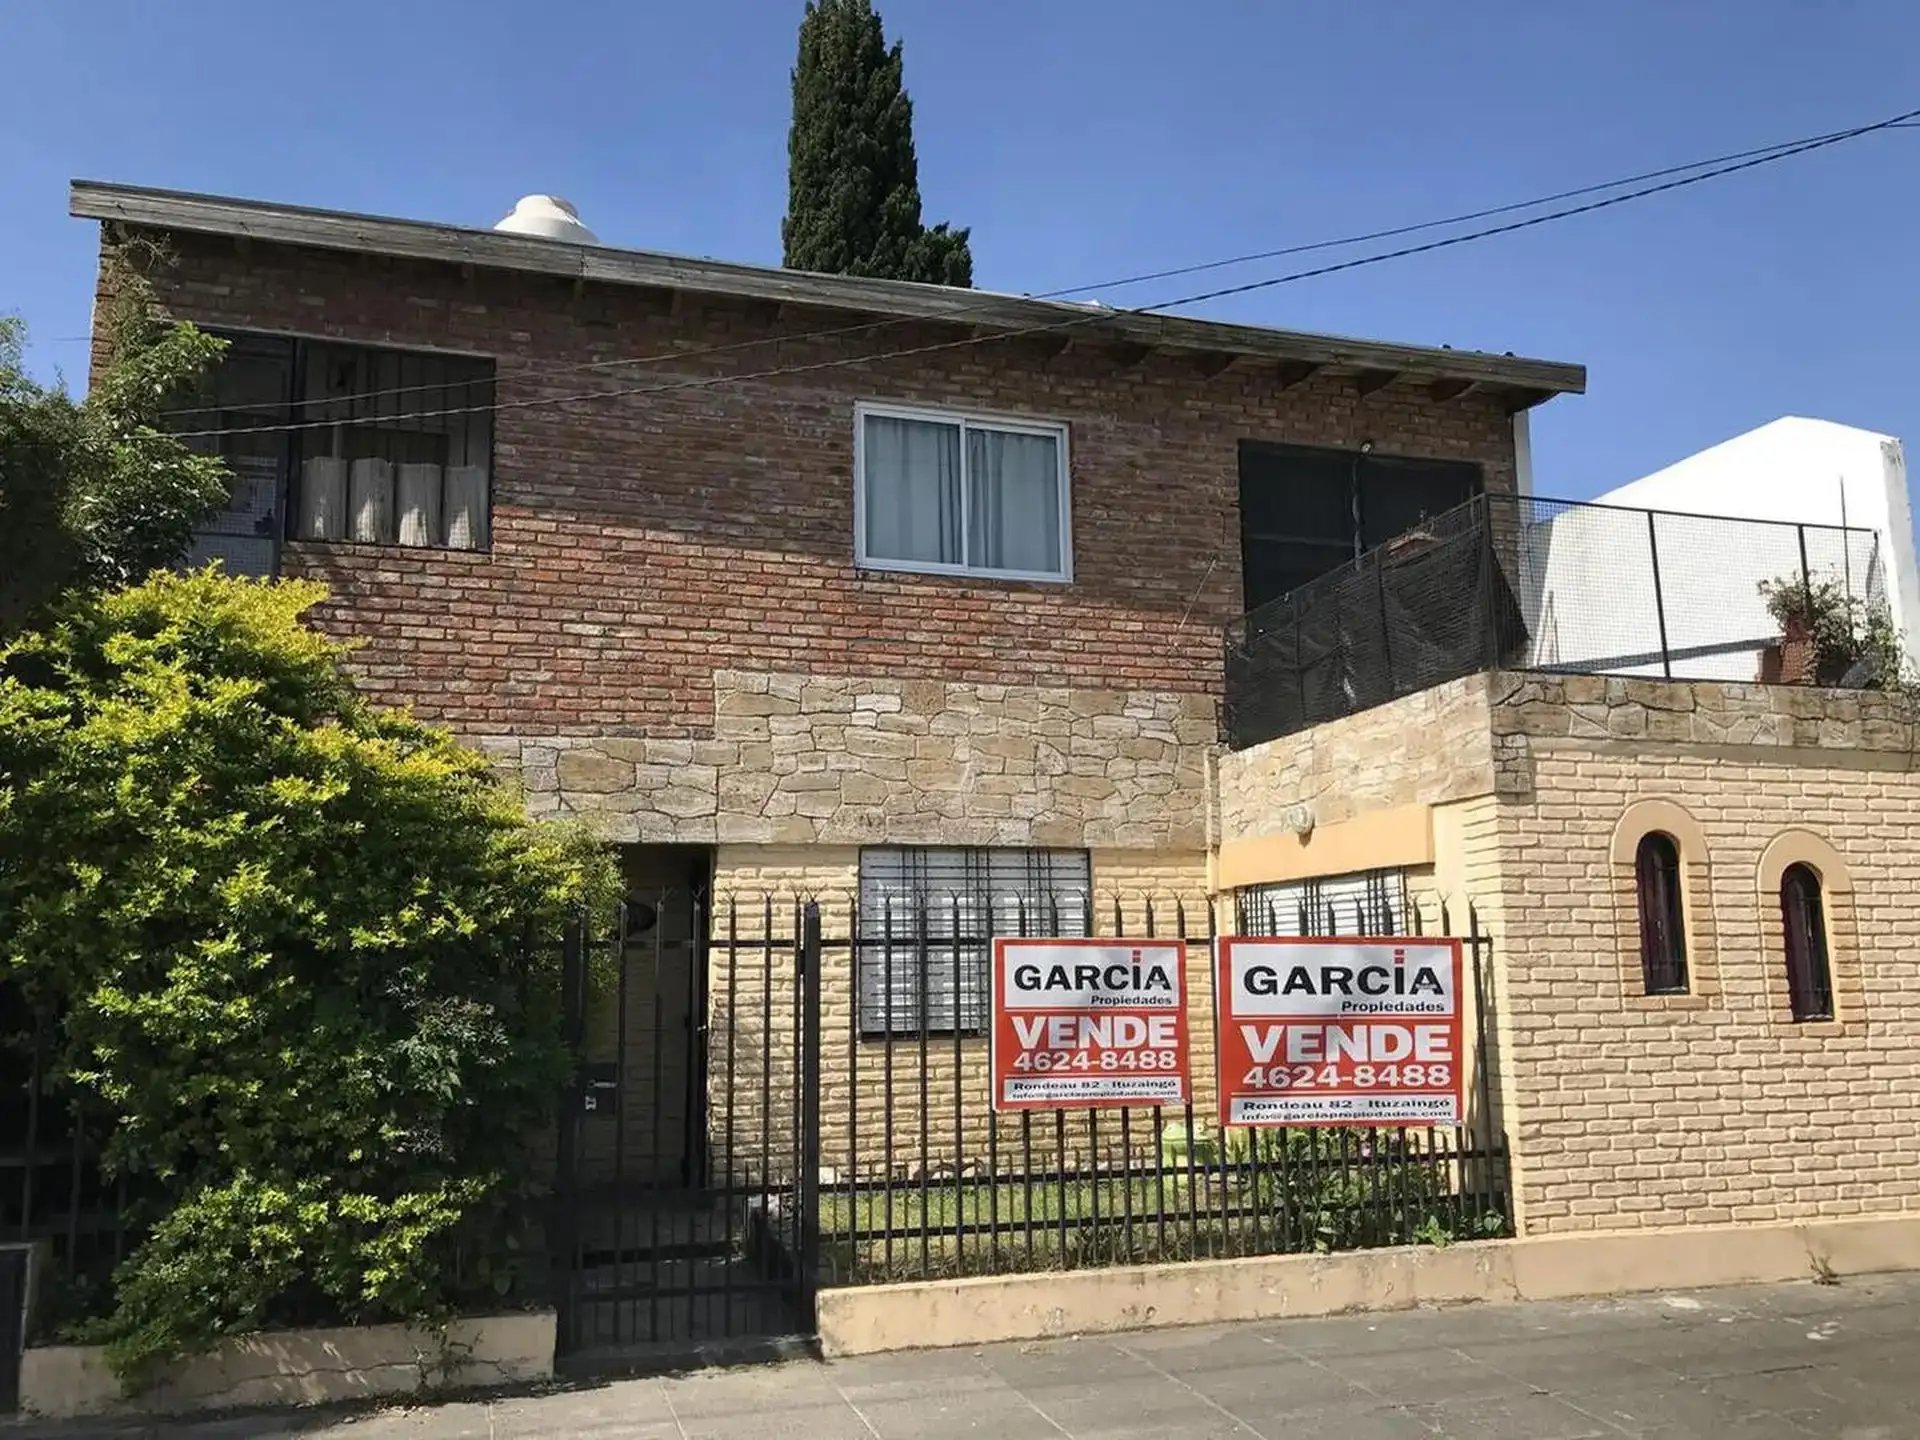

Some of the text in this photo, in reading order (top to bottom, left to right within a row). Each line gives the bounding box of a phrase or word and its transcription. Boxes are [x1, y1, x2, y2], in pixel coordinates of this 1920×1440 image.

[1090, 995, 1172, 1007] Propiedades
[1341, 1001, 1445, 1014] Propiedades
[1011, 1015, 1179, 1050] VENDE
[1239, 1024, 1453, 1064] VENDE
[1013, 1050, 1177, 1072] 4624-8488
[1242, 1064, 1451, 1089] 4624-8488
[1013, 1081, 1077, 1091] Rondeau
[1243, 1101, 1323, 1111] Rondeau
[1328, 1099, 1353, 1109] 82
